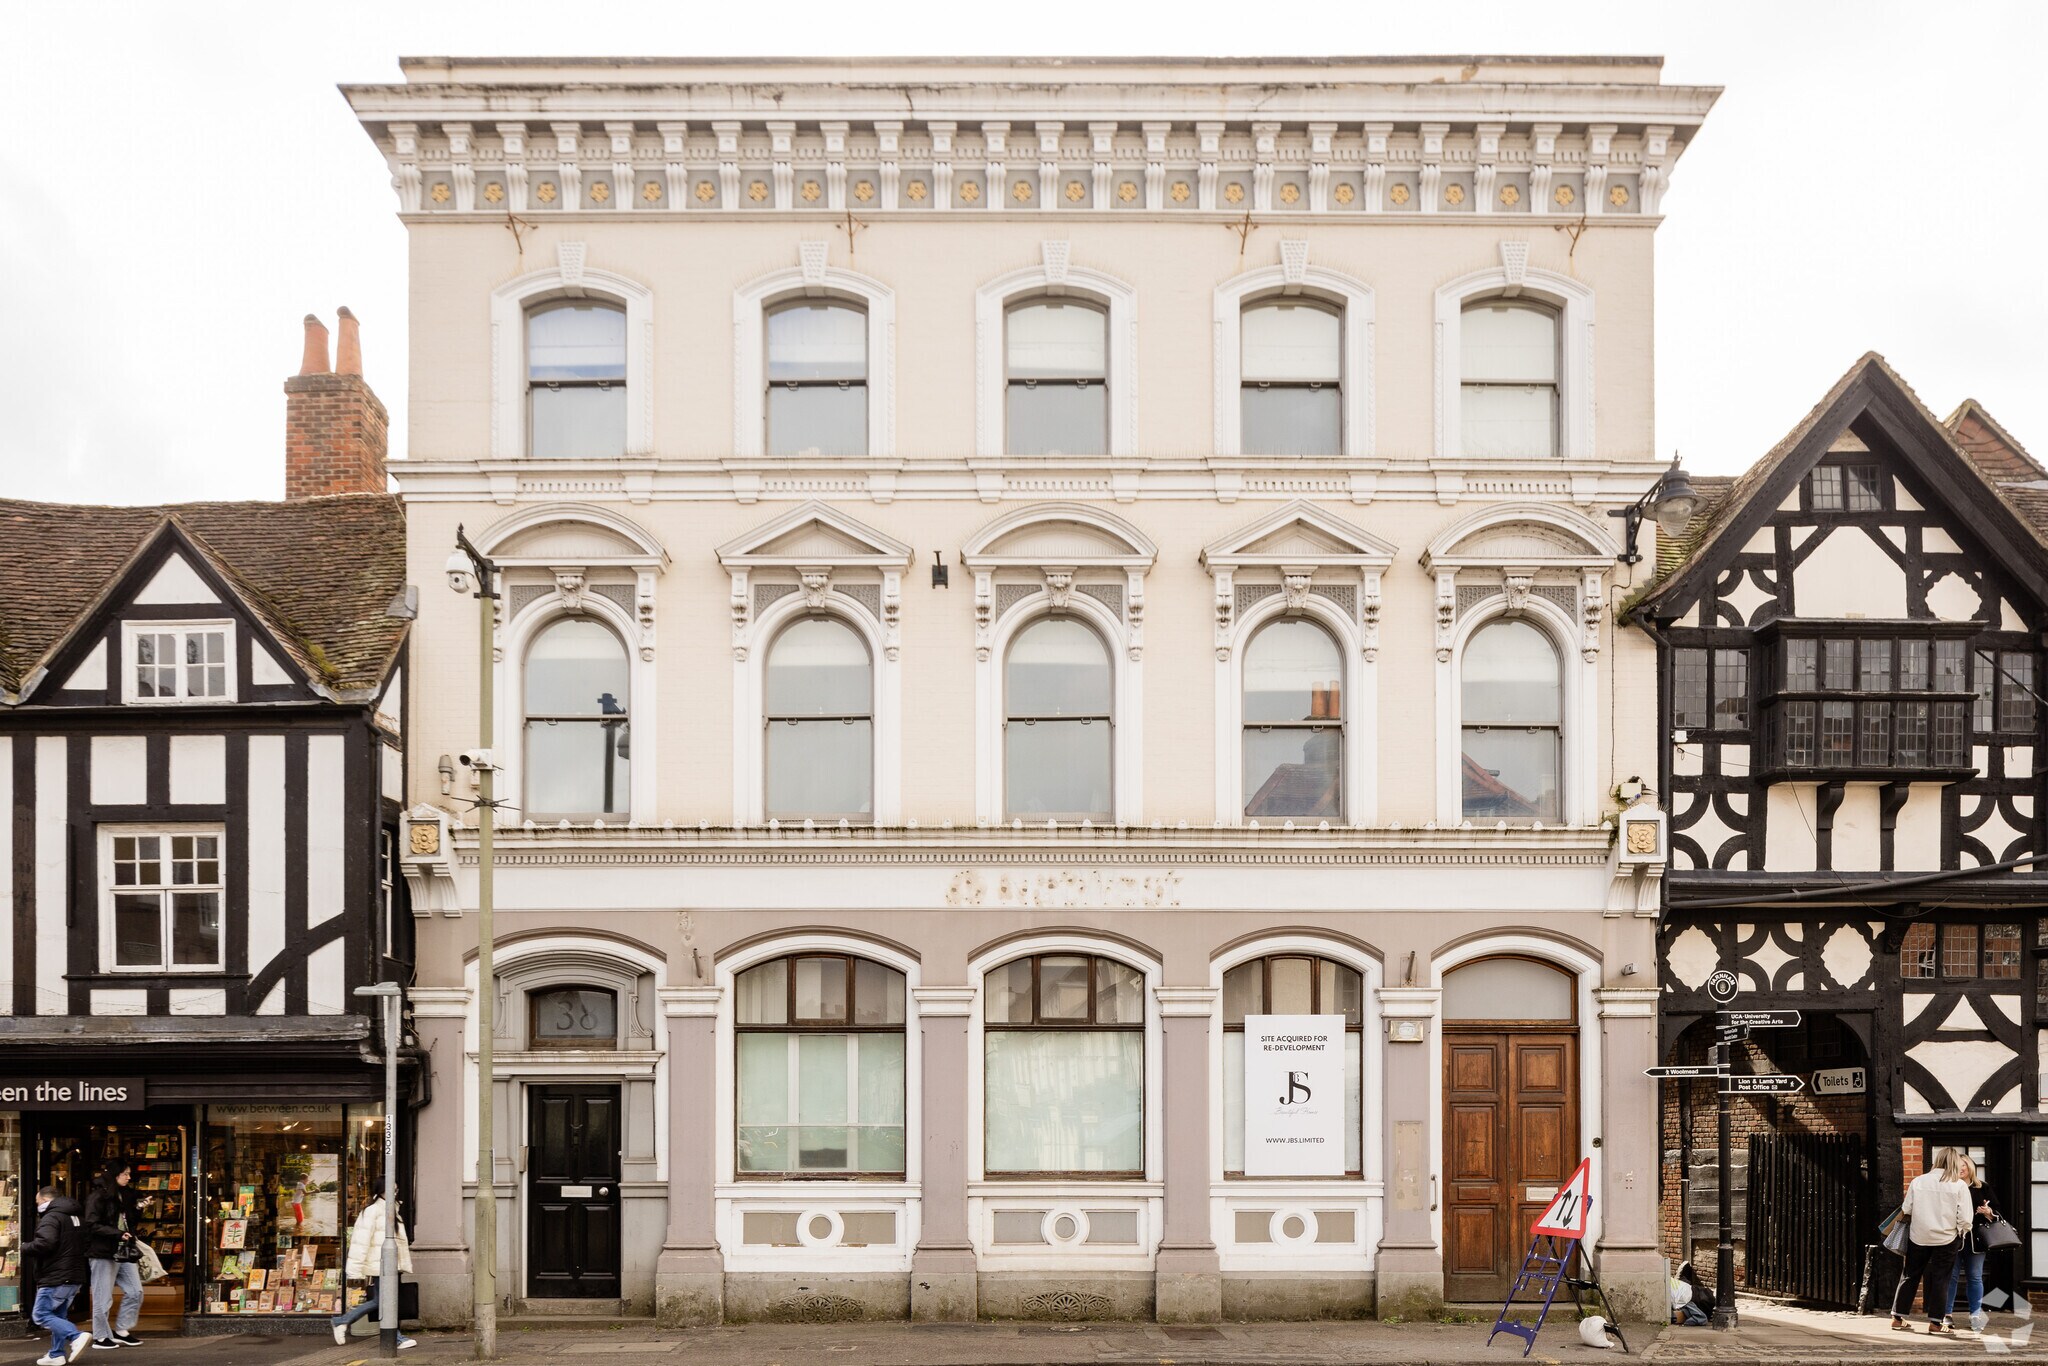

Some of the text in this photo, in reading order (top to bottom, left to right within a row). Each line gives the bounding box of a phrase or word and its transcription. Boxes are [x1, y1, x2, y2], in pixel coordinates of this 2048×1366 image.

[1711, 973, 1735, 986] FARNHAM
[556, 1000, 598, 1030] 38
[1276, 1035, 1313, 1043] ACQUIRED
[1823, 1075, 1849, 1087] Toilets
[35, 1080, 72, 1102] the
[79, 1080, 128, 1102] lines
[216, 1103, 331, 1114] www.between.co.uk
